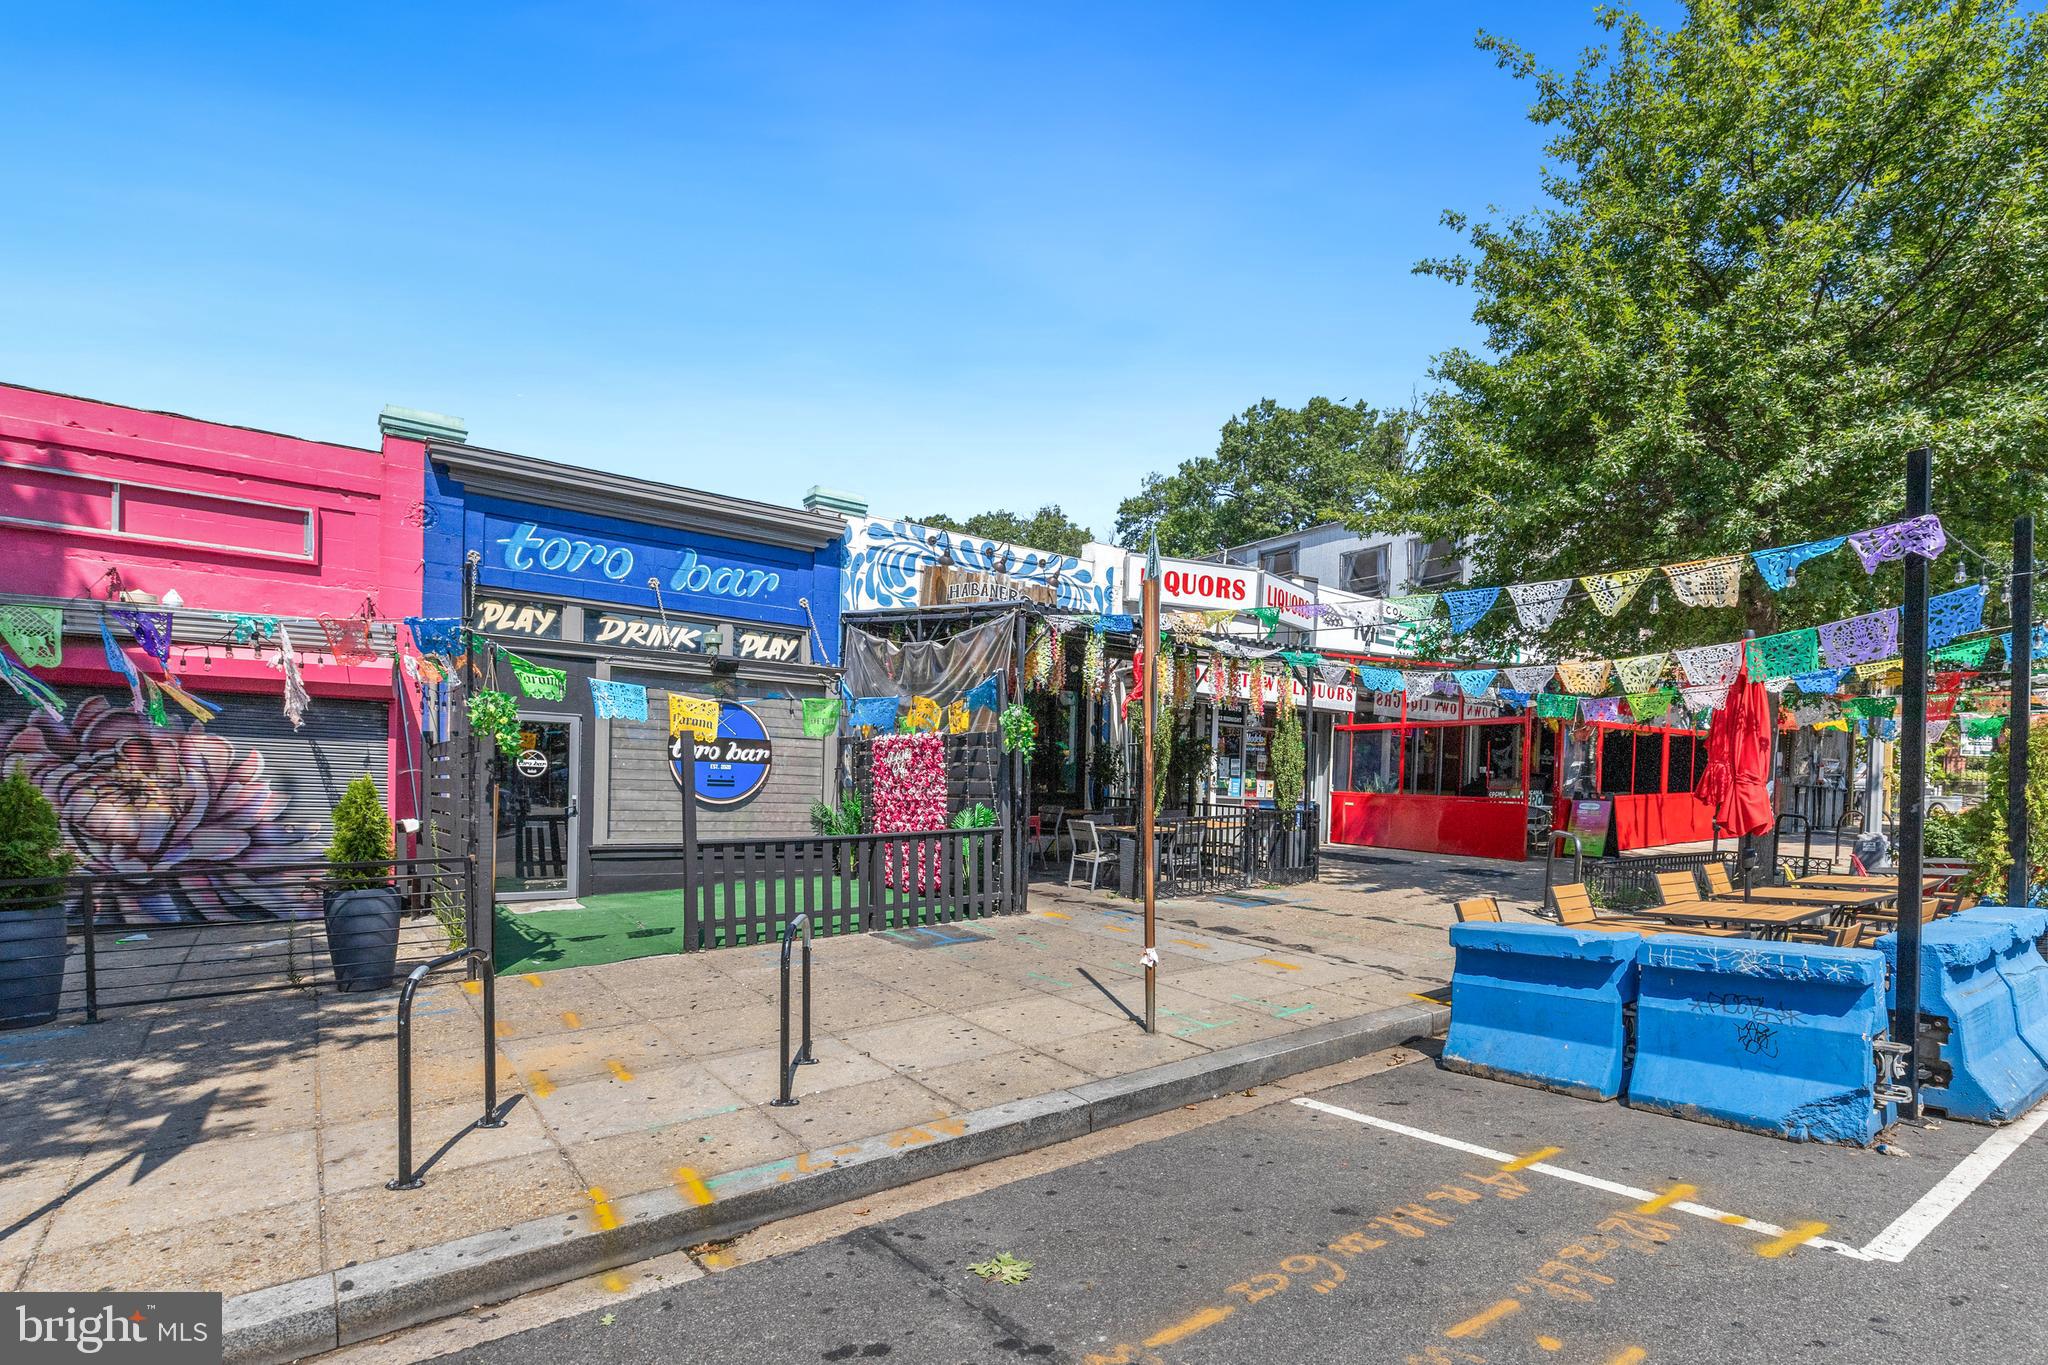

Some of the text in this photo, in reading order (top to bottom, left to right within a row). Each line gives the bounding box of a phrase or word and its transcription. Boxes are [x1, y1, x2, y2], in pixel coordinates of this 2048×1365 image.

[497, 521, 780, 599] toro bar
[477, 600, 556, 635] PLAY
[595, 614, 704, 650] DRINK
[738, 630, 800, 662] PLAY
[668, 737, 771, 762] tro bar
